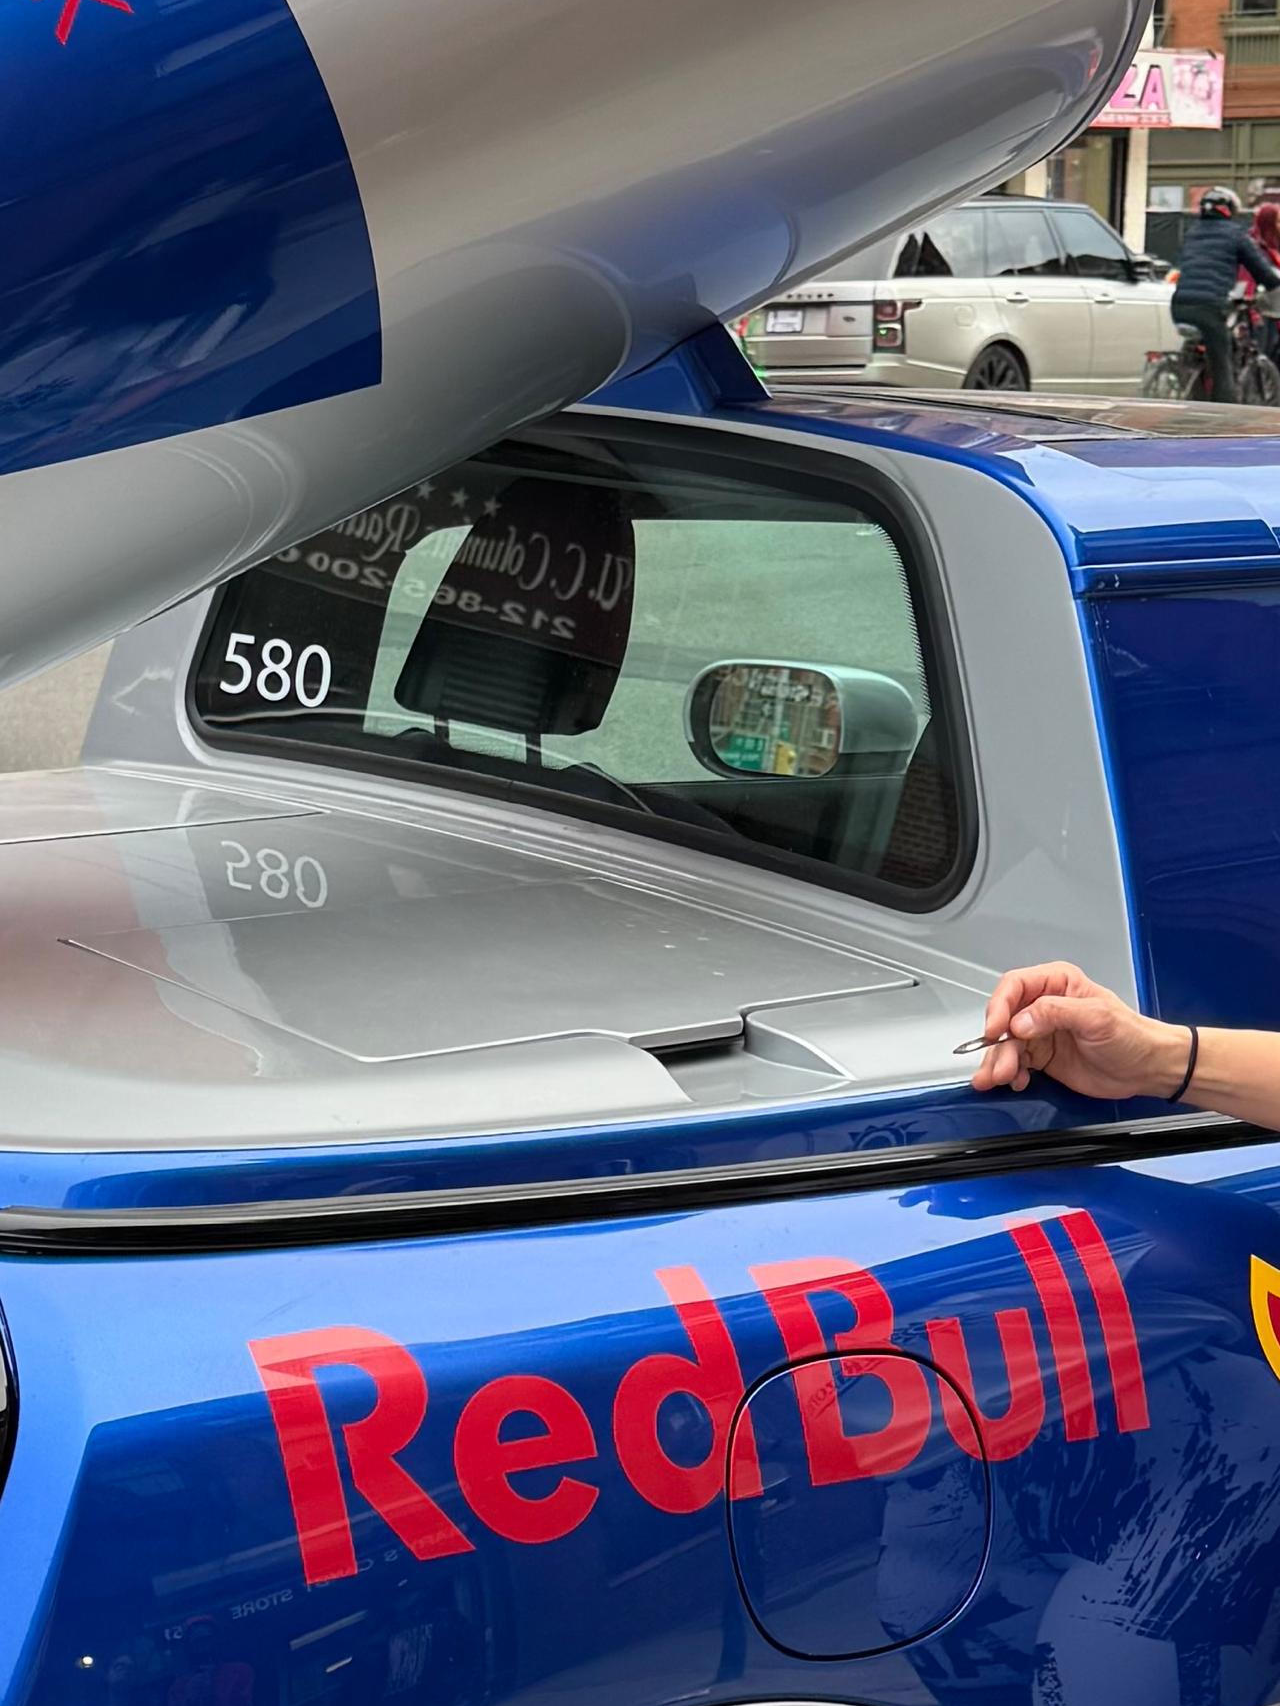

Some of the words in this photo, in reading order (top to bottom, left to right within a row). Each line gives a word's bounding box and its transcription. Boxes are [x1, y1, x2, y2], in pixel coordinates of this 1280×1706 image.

[219, 632, 332, 708] 580
[248, 1264, 765, 1586] Red
[747, 1208, 1150, 1488] Bull
